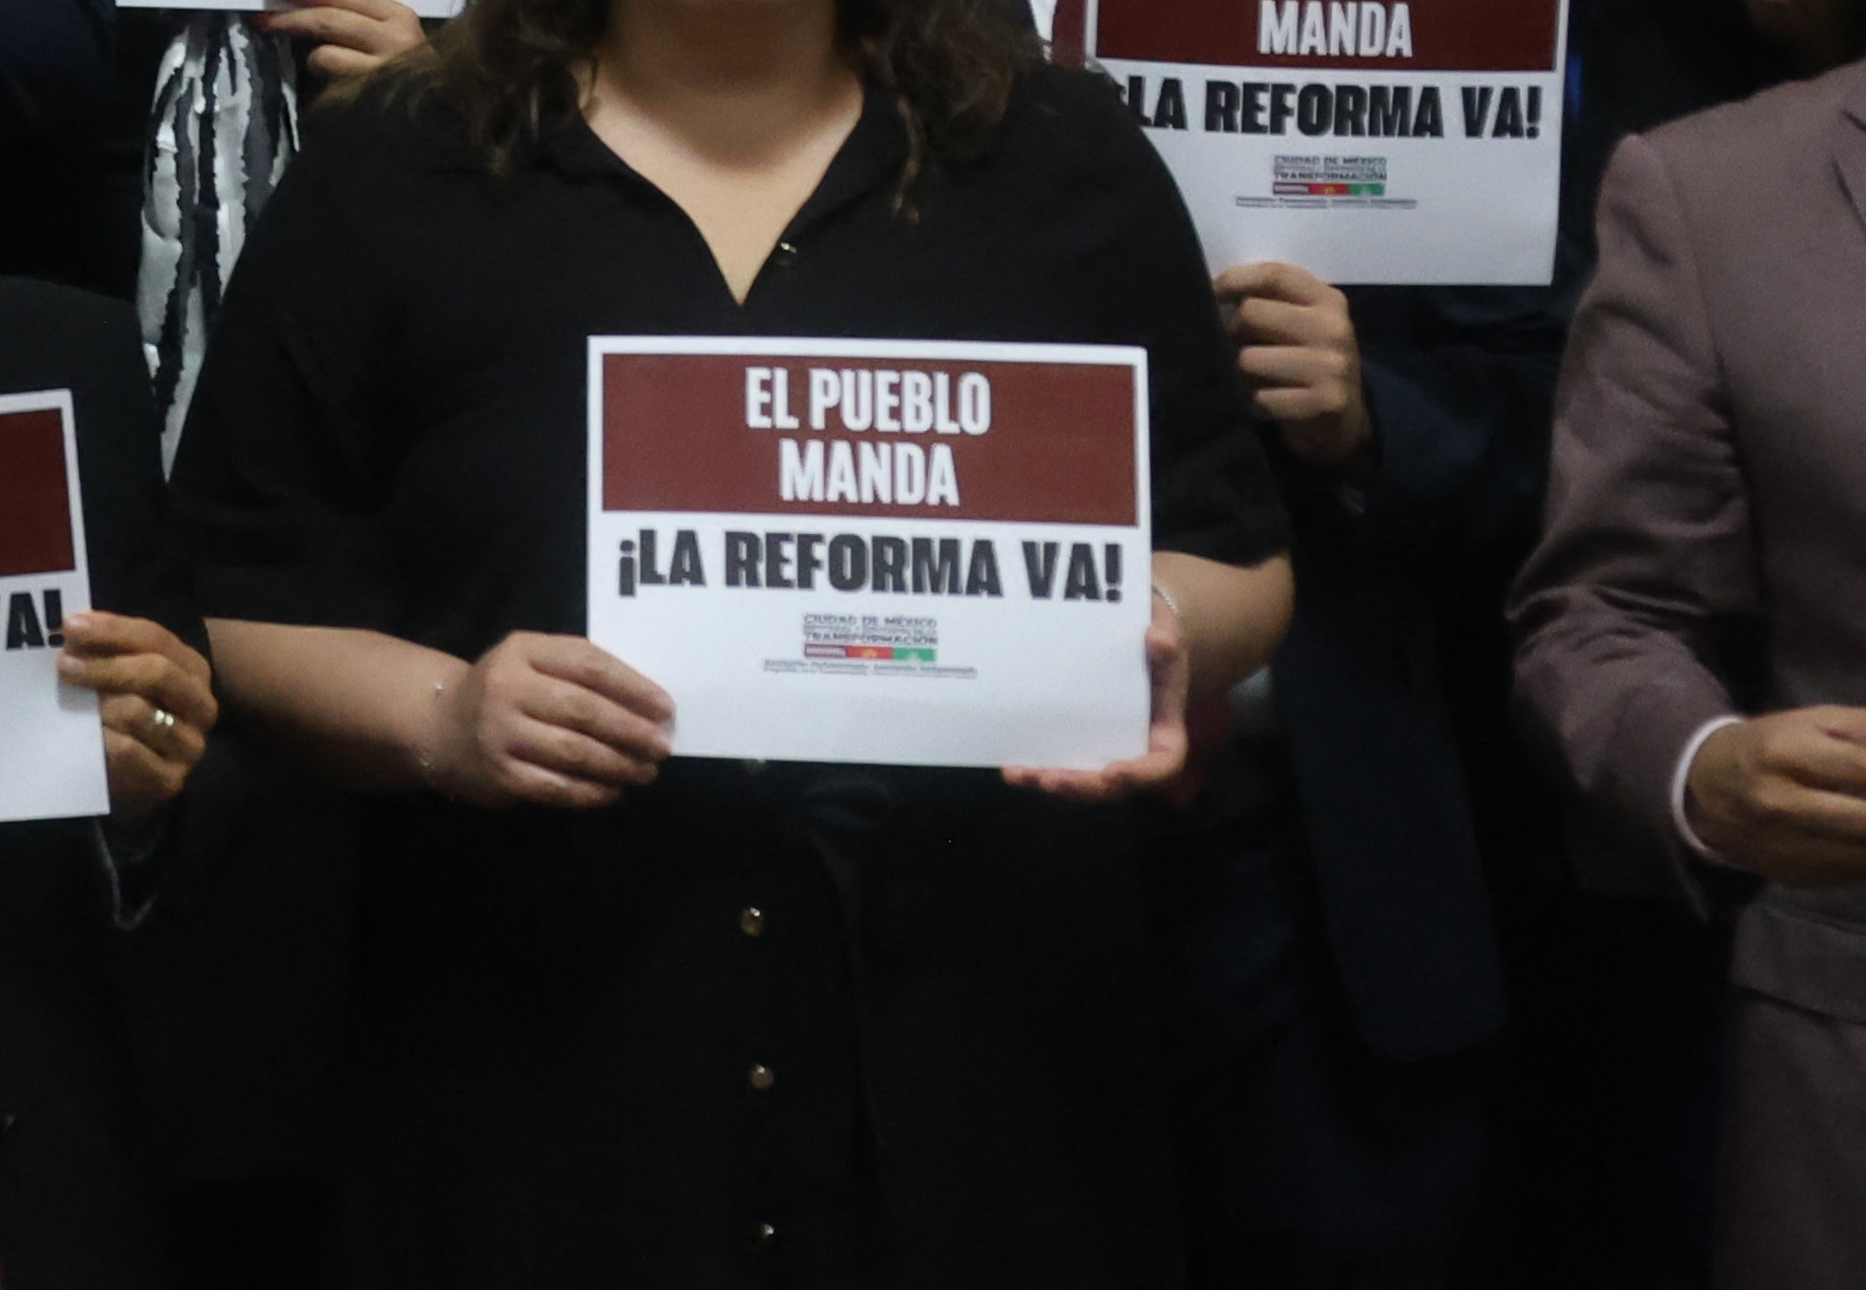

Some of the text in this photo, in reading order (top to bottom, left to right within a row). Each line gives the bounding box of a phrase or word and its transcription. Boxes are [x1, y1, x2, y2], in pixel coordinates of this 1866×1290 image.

[747, 367, 990, 436] EL PUEBLO
[780, 439, 959, 505] MANDA
[620, 530, 1120, 601] ¡LA REFORMA VA!
